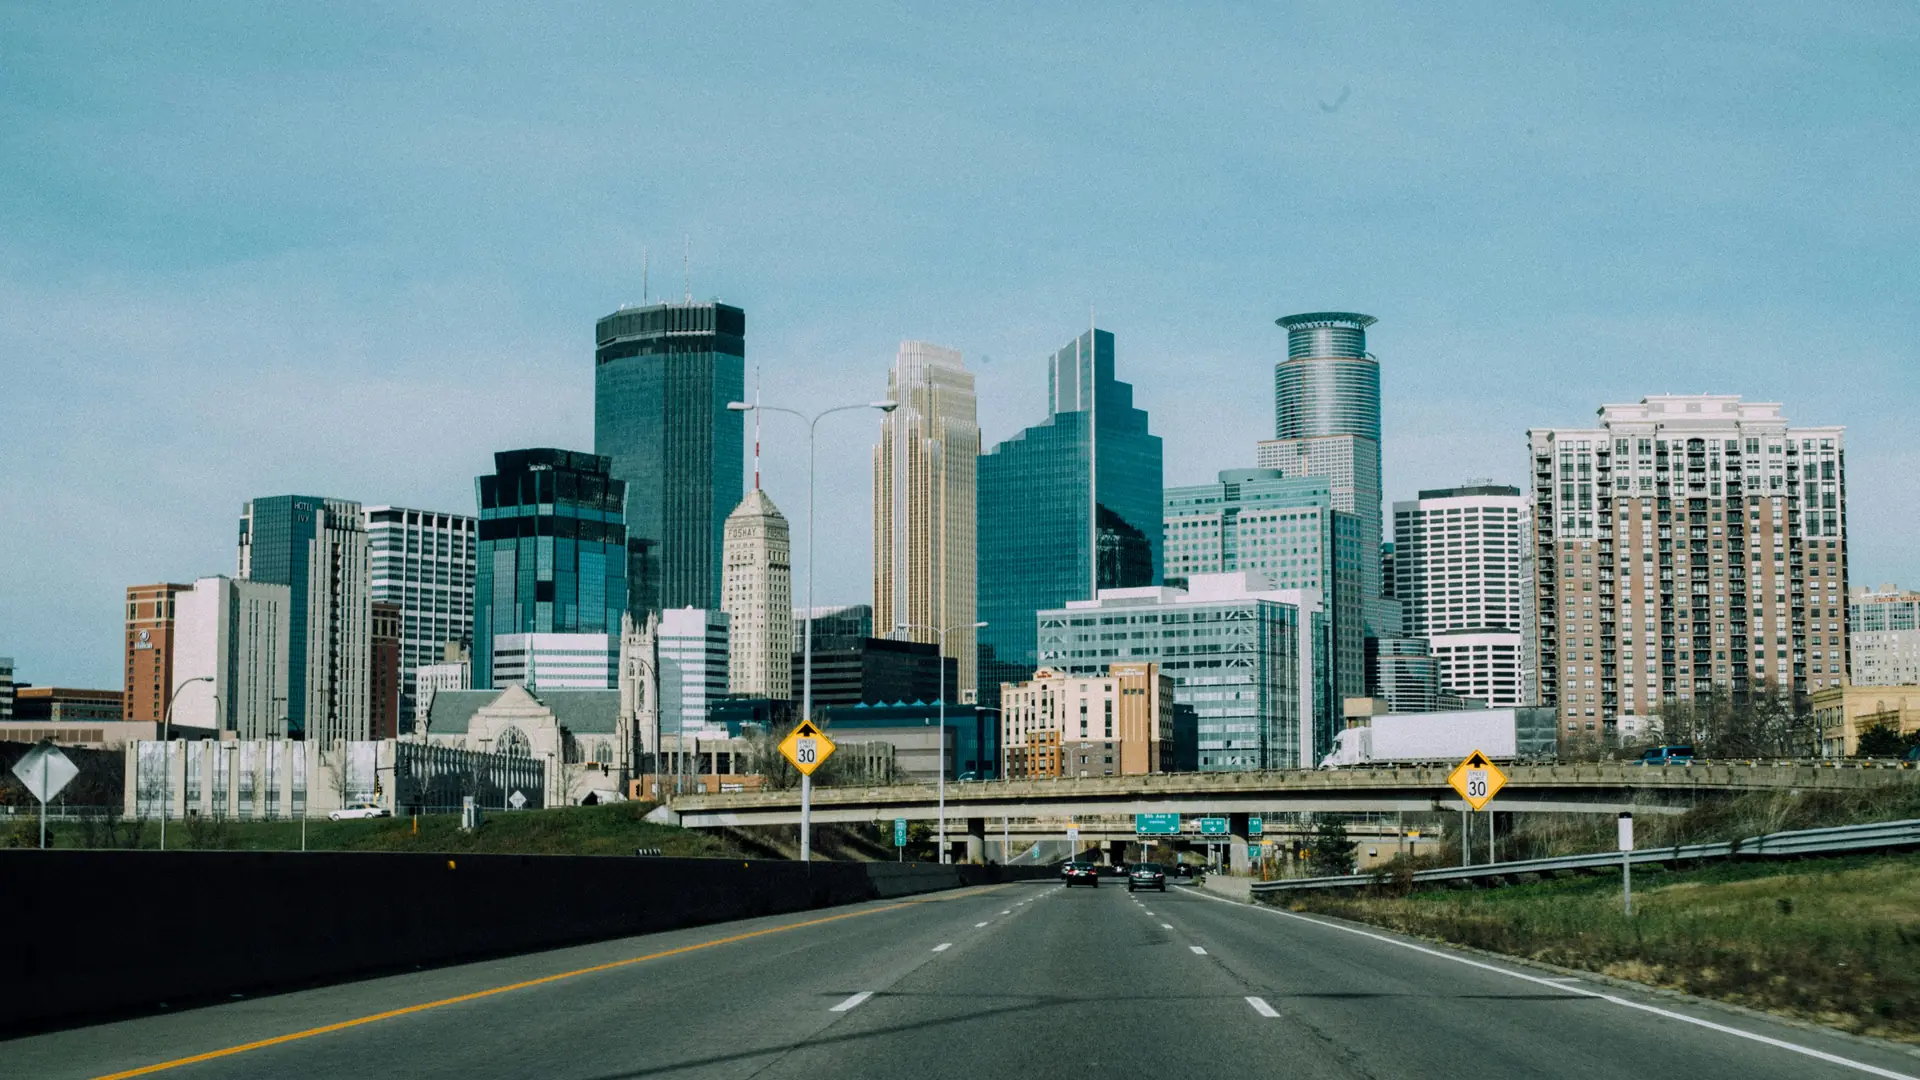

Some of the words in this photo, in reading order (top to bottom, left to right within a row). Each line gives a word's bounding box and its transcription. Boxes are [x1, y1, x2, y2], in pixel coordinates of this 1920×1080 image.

[294, 501, 312, 512] HOTEL
[297, 514, 309, 523] IVY
[728, 527, 757, 538] FOSHAY
[798, 748, 815, 763] 30
[1468, 781, 1486, 796] 30
